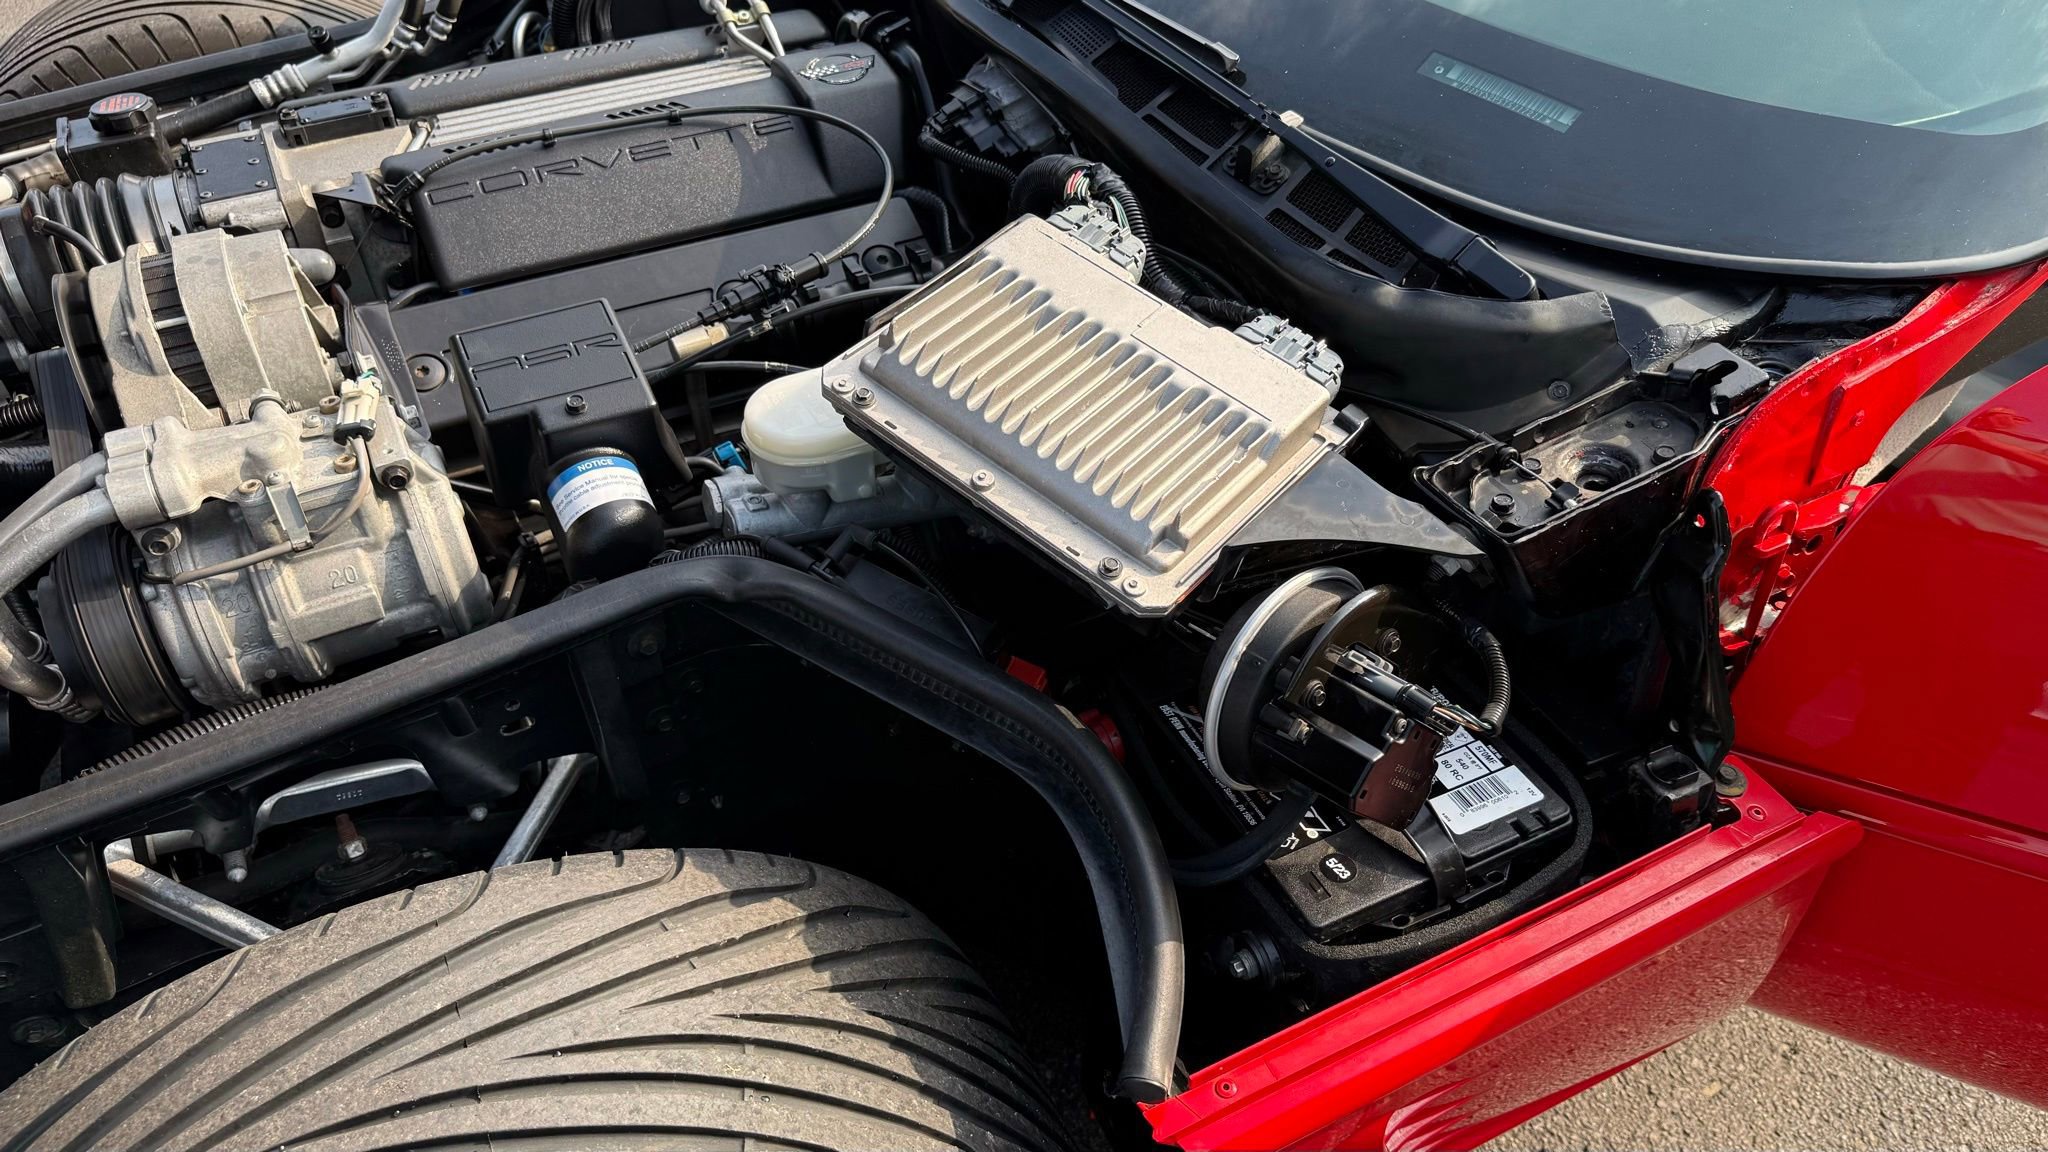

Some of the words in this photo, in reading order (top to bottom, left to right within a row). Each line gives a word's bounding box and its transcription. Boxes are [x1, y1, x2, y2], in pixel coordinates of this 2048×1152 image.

[424, 114, 794, 206] CORVETTE
[468, 332, 623, 380] ASR
[577, 459, 615, 472] NOTICE
[328, 565, 359, 589] 20
[221, 593, 251, 619] 20
[1160, 705, 1174, 717] EAST
[1455, 758, 1469, 770] 540
[1463, 751, 1473, 760] CCA
[1475, 745, 1498, 764] 570MF
[1440, 759, 1453, 769] 80
[1450, 769, 1464, 781] RC
[1526, 787, 1537, 797] 12V
[1326, 858, 1351, 879] 5/23
